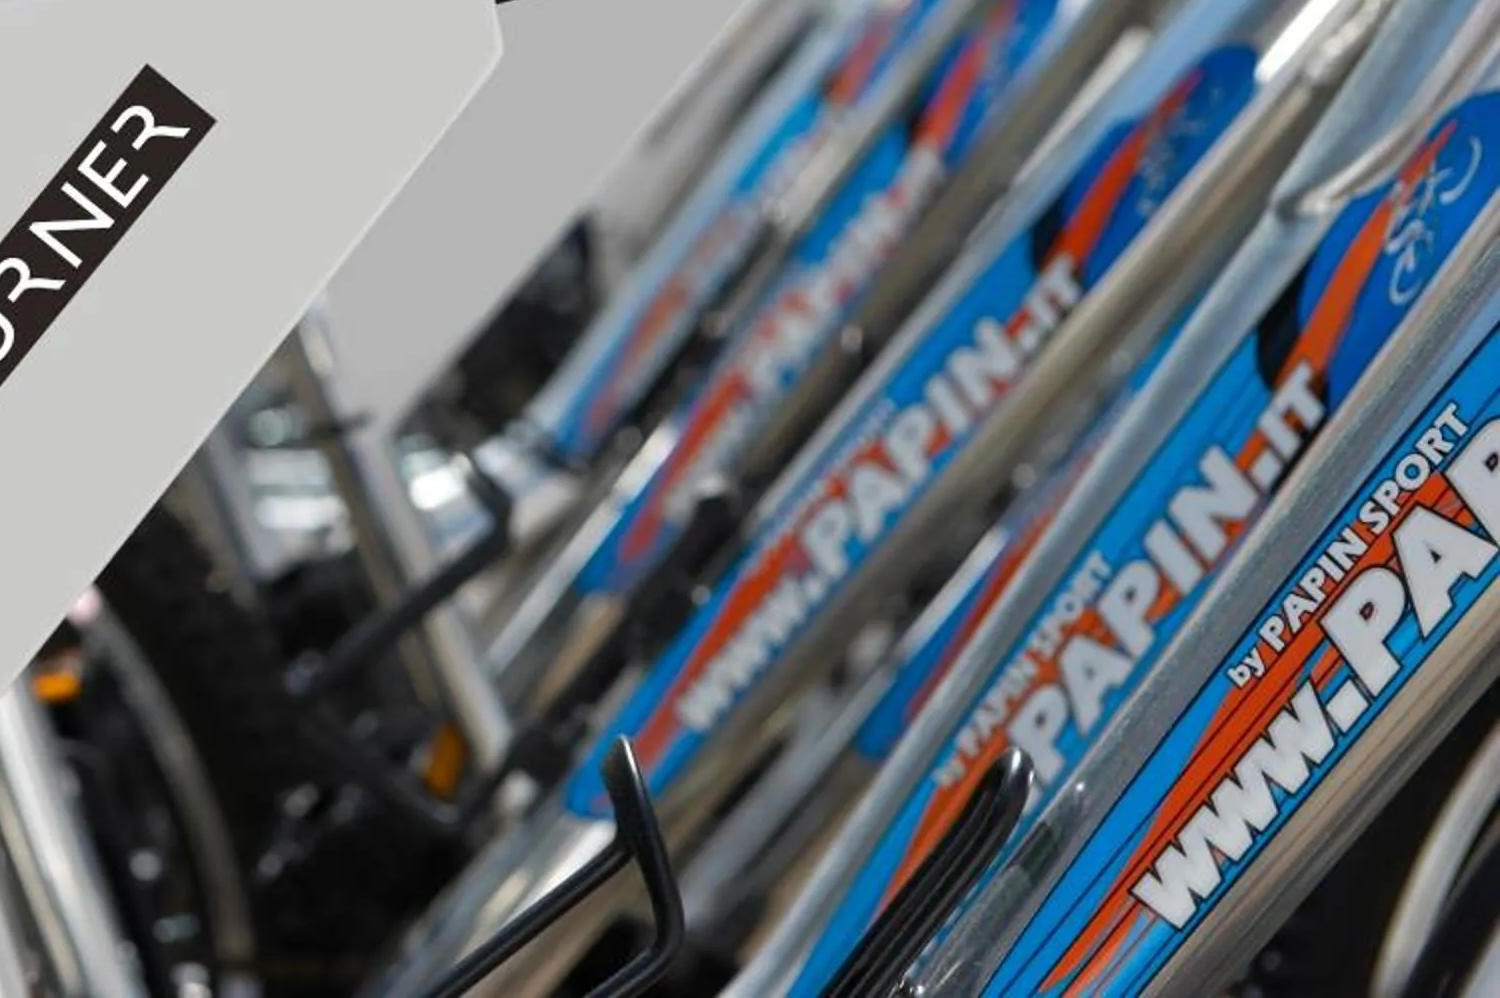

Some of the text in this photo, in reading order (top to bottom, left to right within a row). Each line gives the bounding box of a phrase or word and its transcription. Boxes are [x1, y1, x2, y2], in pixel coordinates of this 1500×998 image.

[1225, 401, 1469, 689] by PAPIN SPORT
